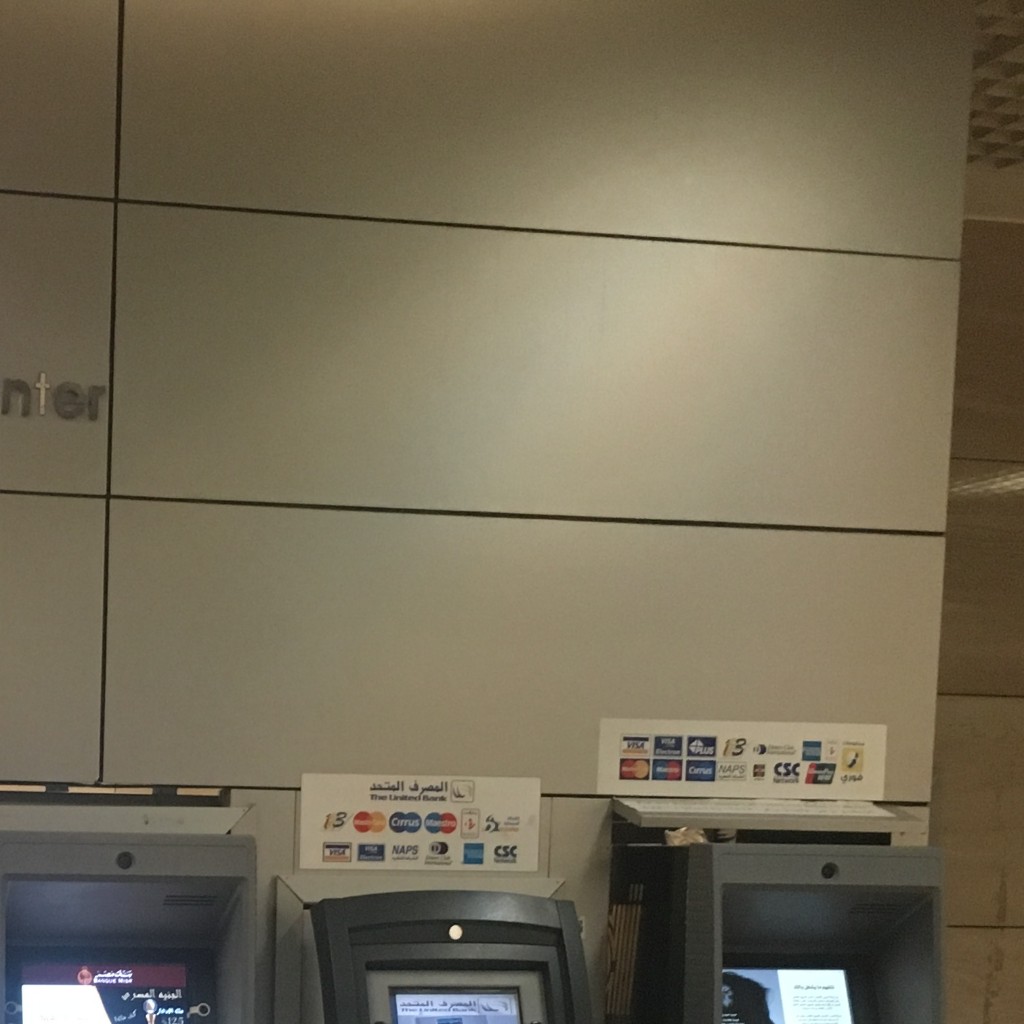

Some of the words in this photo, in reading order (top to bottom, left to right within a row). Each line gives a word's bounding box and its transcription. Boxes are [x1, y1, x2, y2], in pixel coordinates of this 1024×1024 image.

[773, 762, 801, 777] CSC
[391, 817, 420, 827] Cirrus
[392, 845, 419, 855] NAPS
[494, 845, 518, 858] CSC
